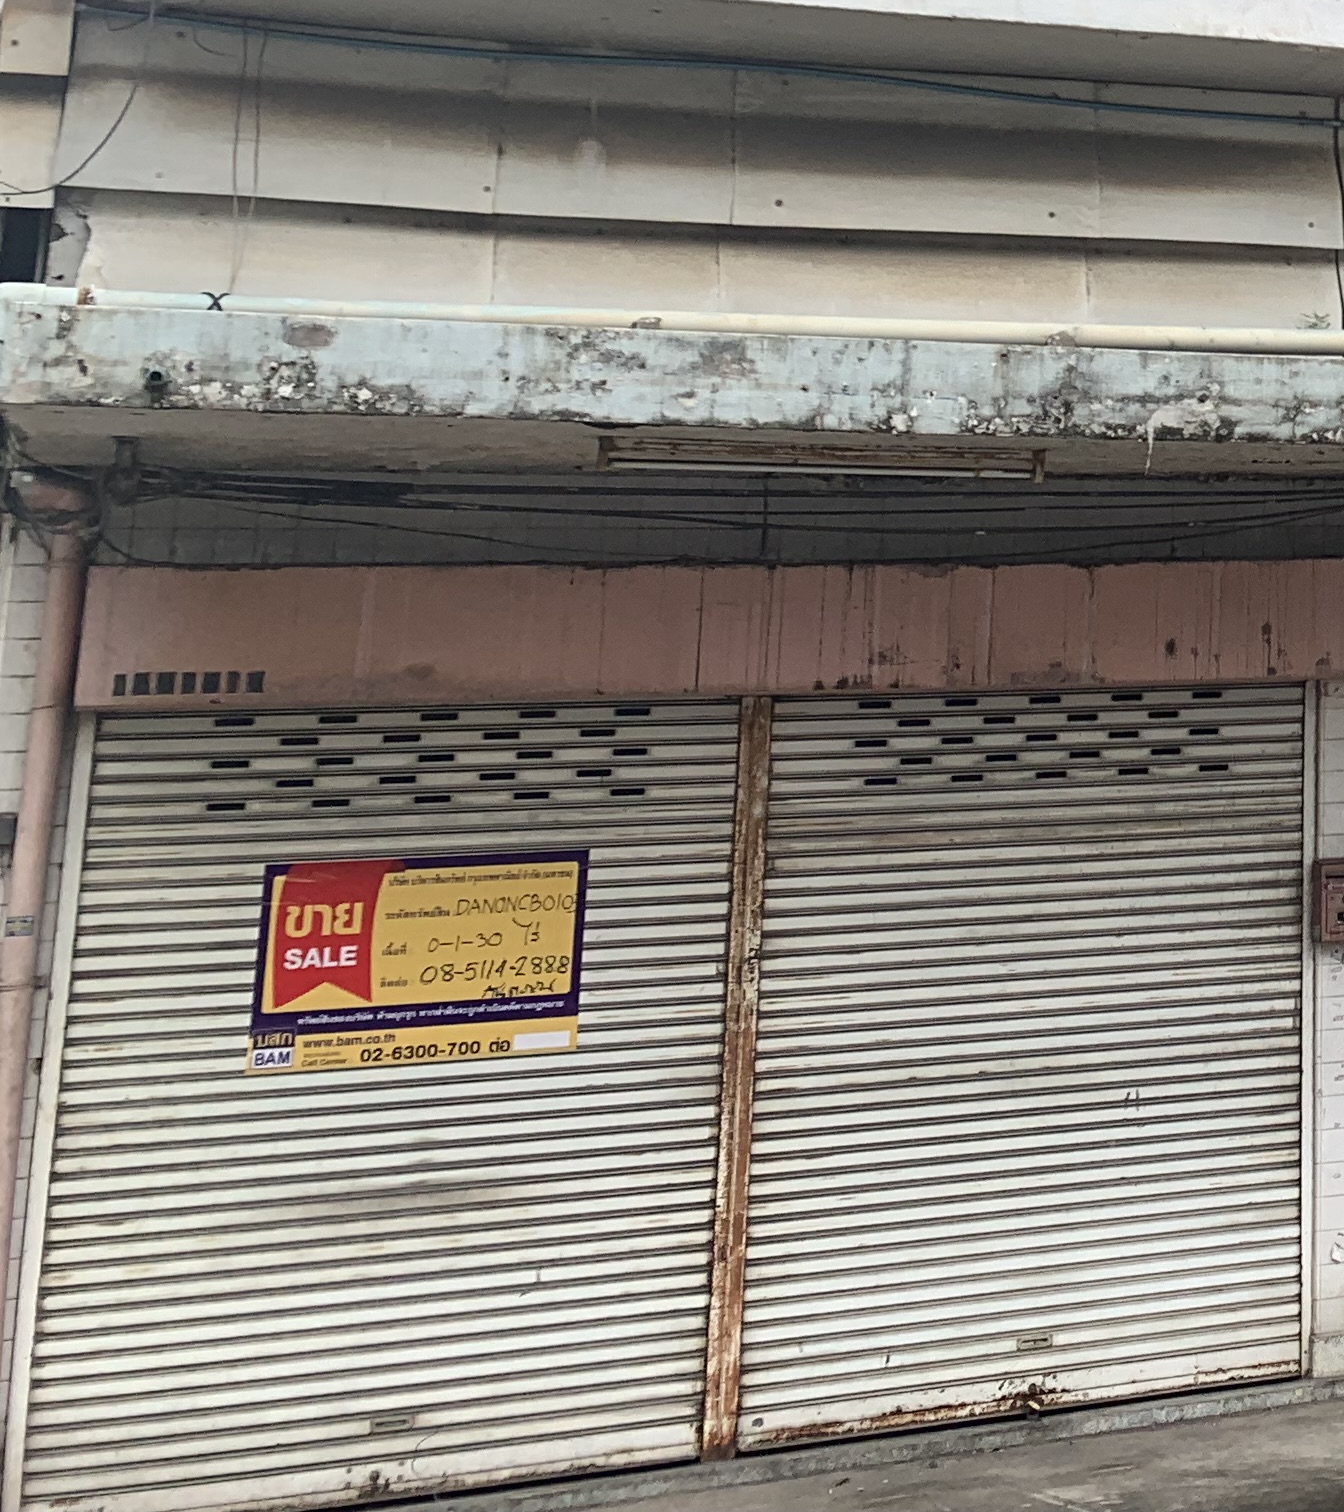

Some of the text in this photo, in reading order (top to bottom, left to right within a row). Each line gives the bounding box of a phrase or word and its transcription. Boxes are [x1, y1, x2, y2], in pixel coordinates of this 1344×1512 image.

[284, 902, 364, 938] ขาย
[427, 932, 503, 953] 0-1-30
[283, 945, 358, 971] SALE
[302, 1032, 396, 1048] www.bam.co.th
[360, 1037, 510, 1063] 02-6300-700 ต่อ
[253, 1049, 292, 1068] BAM
